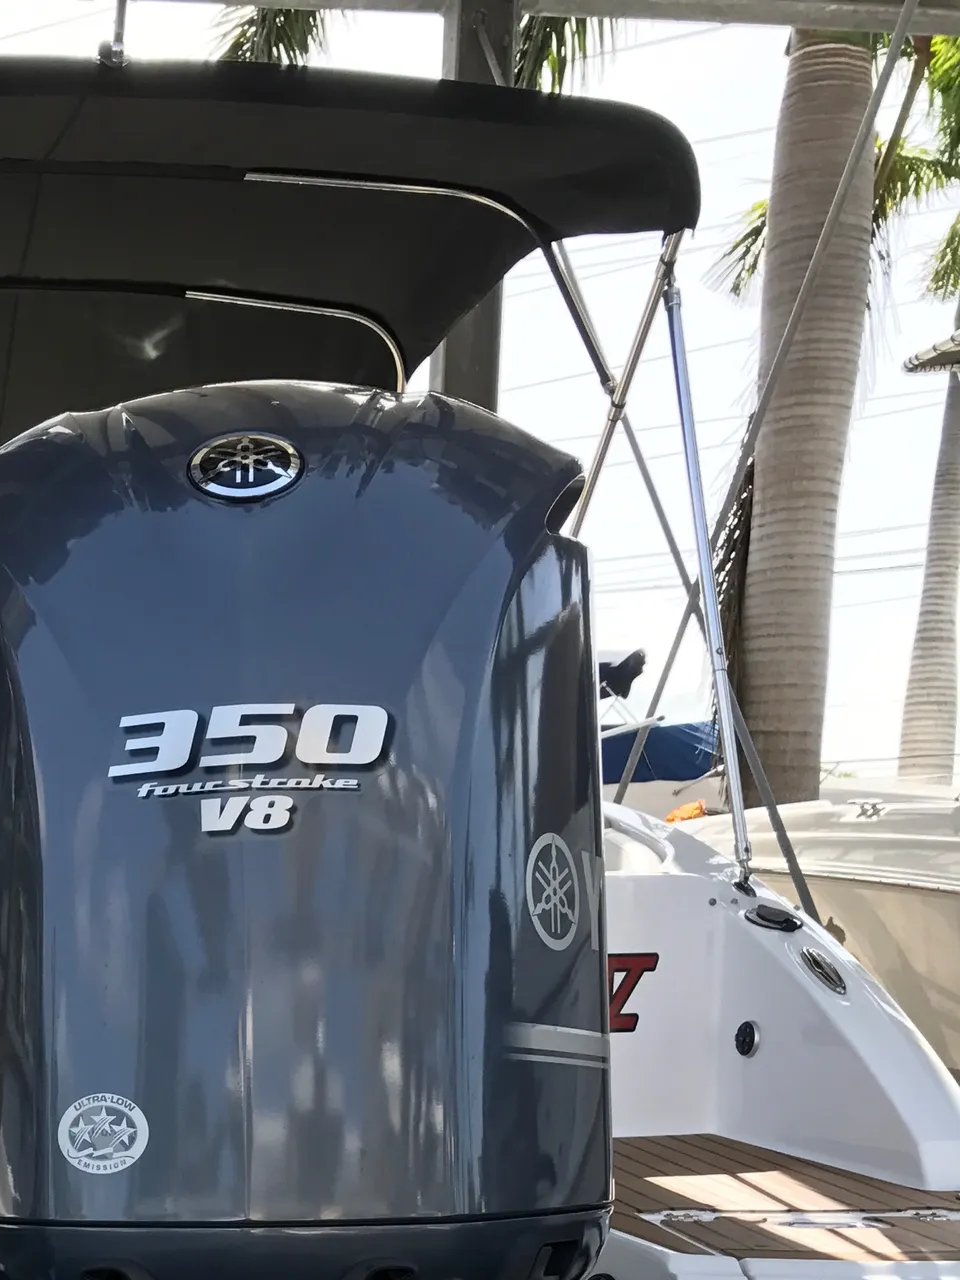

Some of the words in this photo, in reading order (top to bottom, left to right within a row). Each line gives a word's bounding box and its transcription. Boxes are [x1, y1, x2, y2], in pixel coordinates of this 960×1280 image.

[107, 703, 389, 777] 350
[200, 795, 295, 832] V8
[78, 1159, 127, 1170] EMISSION
